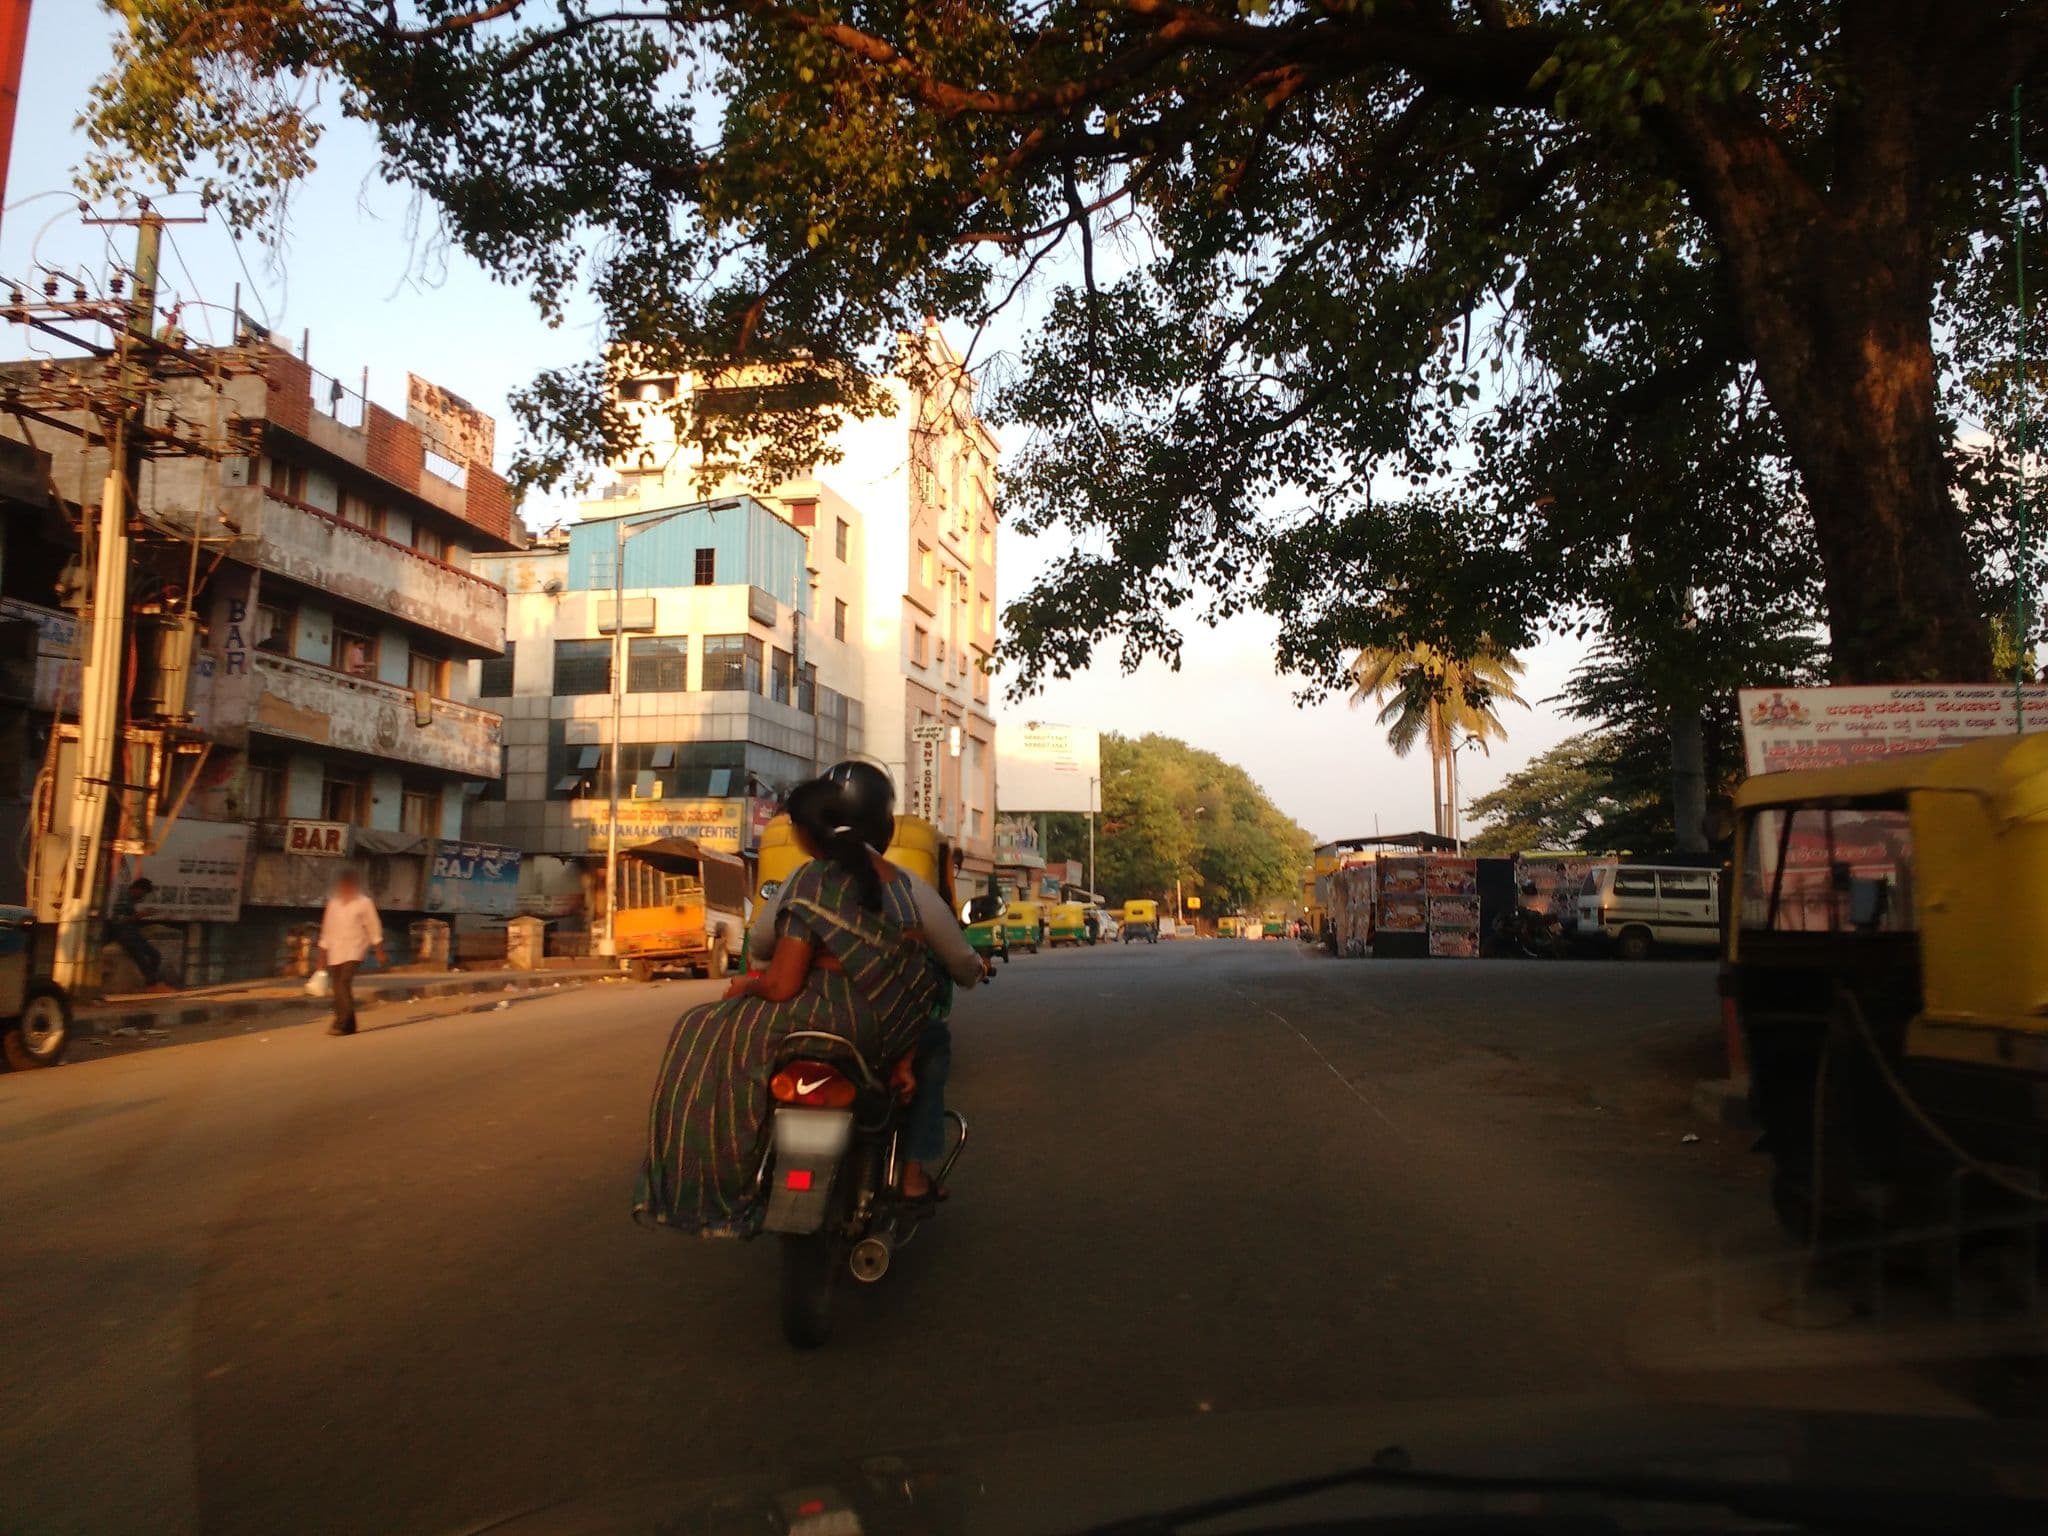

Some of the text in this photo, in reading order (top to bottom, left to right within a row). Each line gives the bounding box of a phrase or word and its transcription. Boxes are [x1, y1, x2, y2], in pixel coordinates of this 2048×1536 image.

[227, 601, 248, 675] BAR
[292, 827, 341, 850] BAR
[699, 826, 738, 839] CENTRE
[433, 857, 475, 879] RAJ
